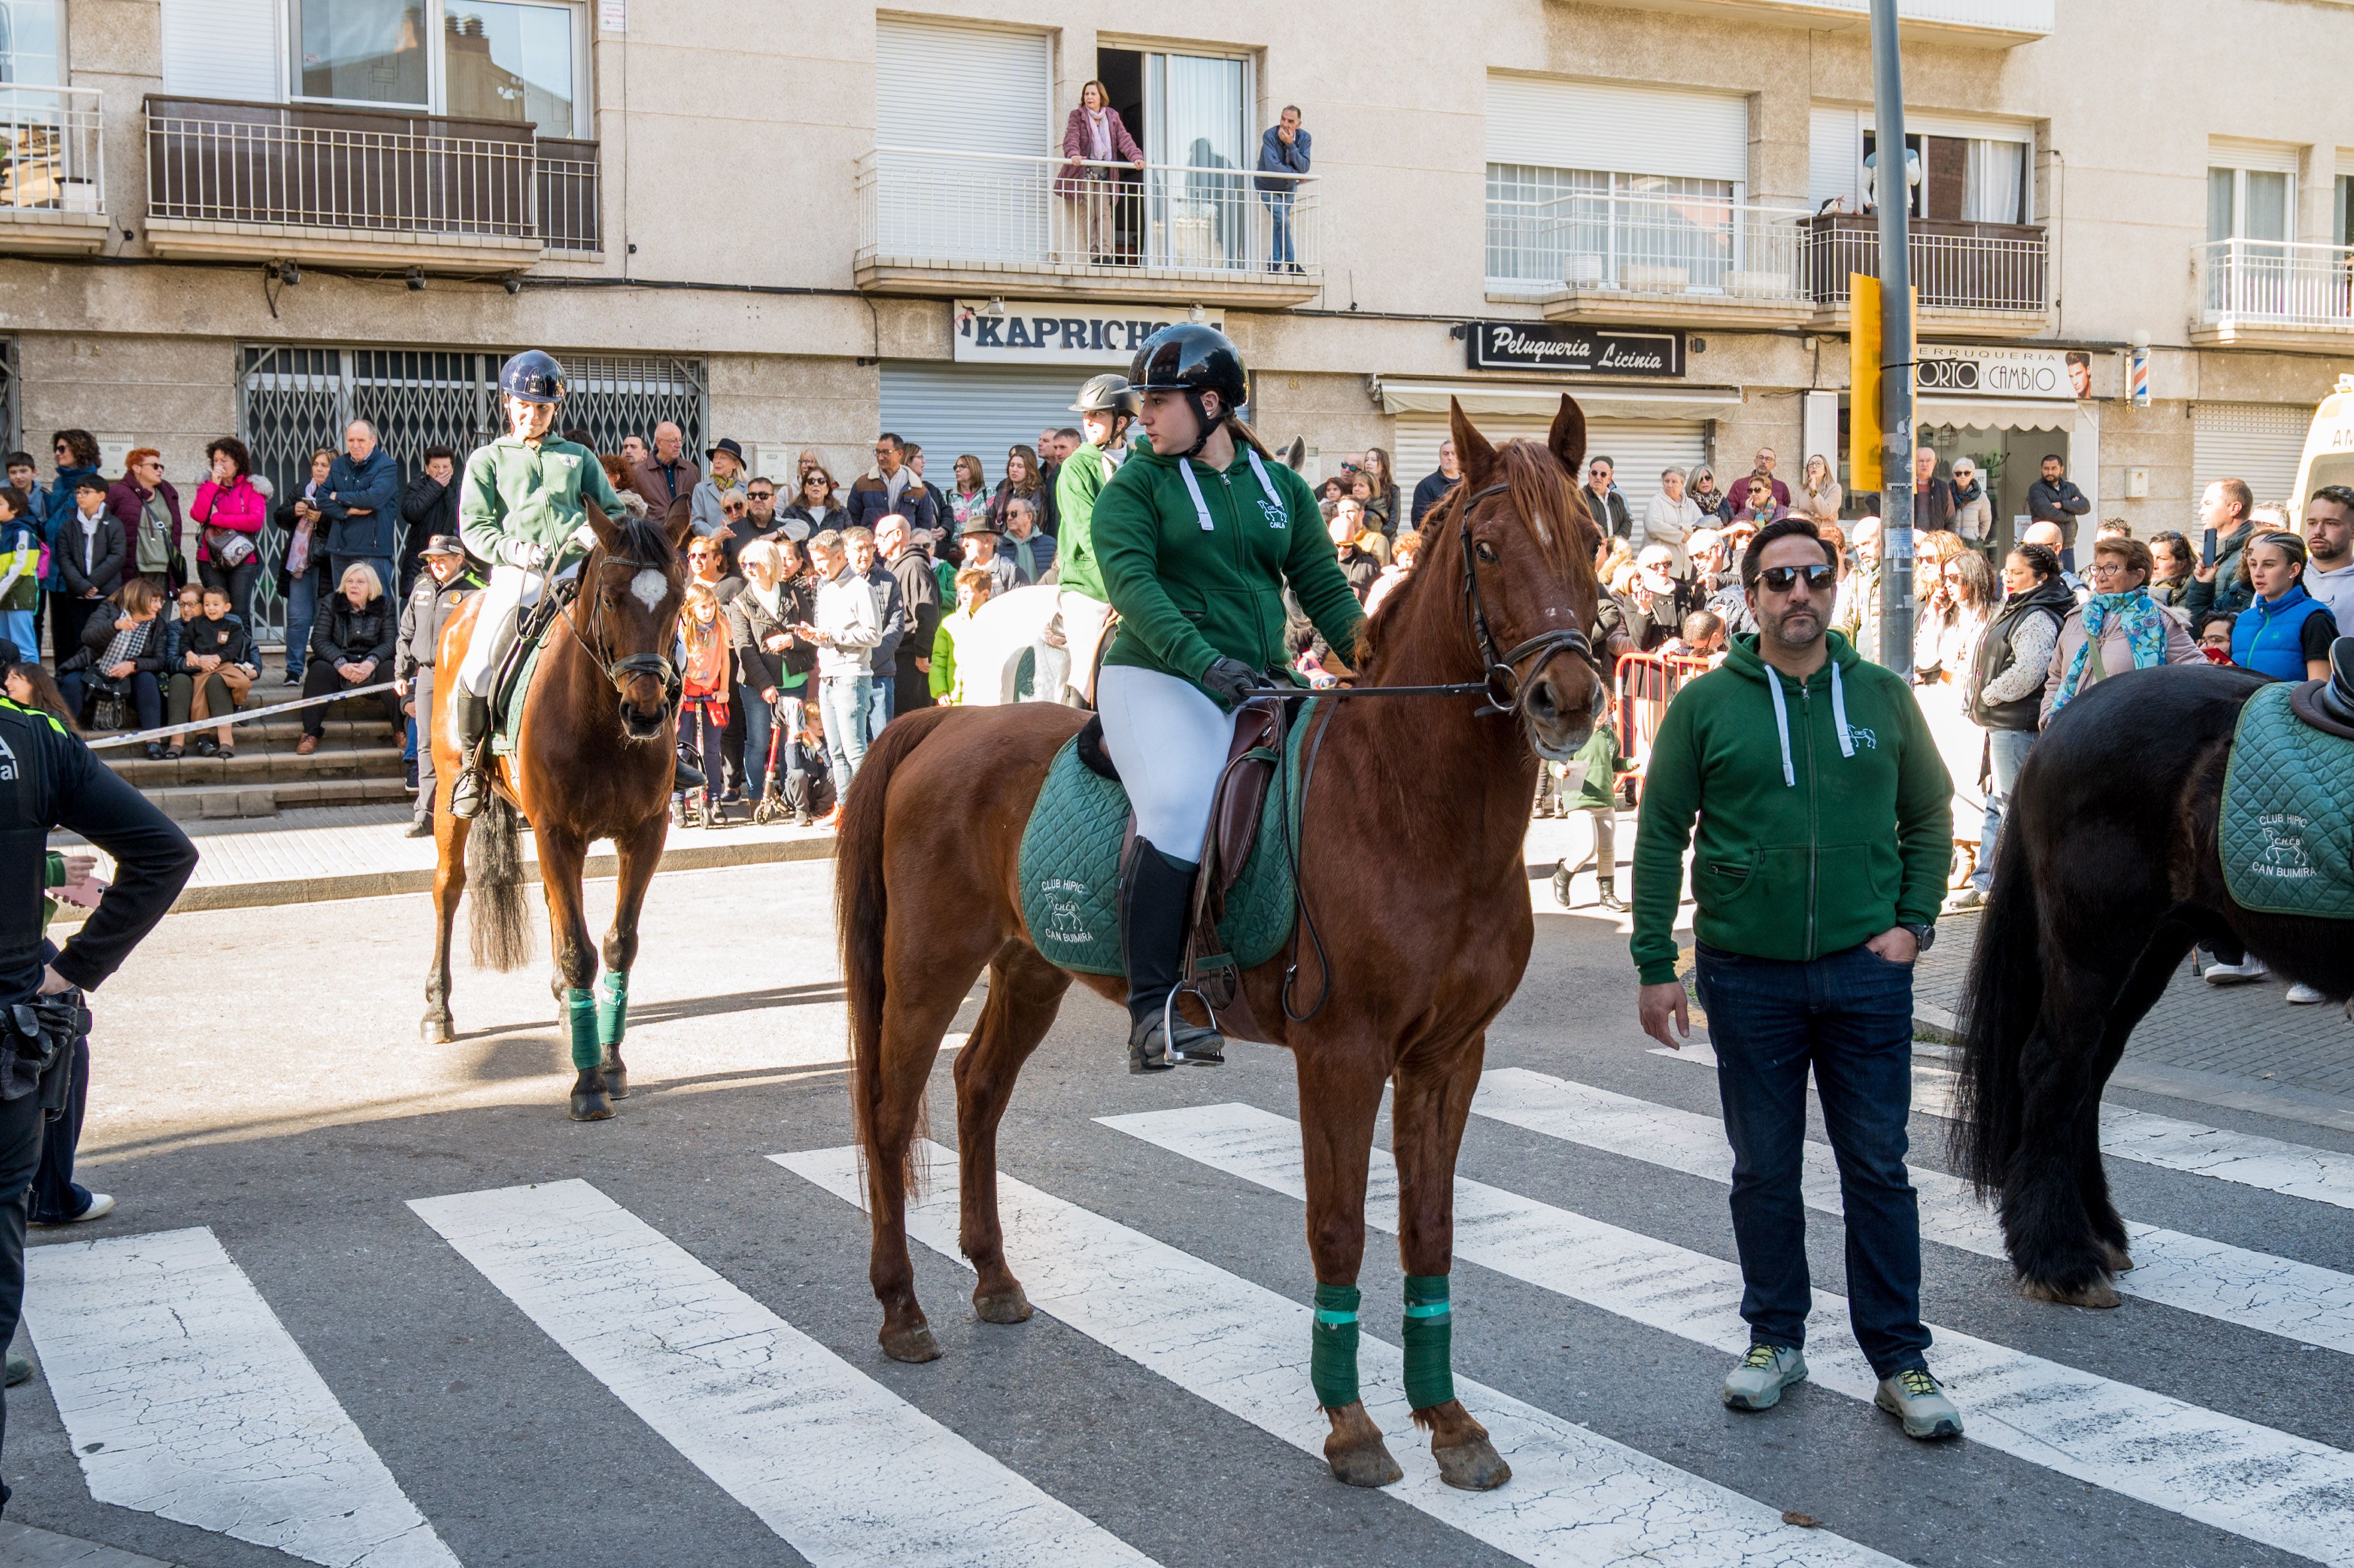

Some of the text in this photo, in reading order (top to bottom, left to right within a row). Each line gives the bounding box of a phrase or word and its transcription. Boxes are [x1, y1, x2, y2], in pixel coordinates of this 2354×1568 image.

[975, 316, 1222, 350] KAPRICH
[1492, 326, 1663, 368] Peluqueria Licinia
[1919, 347, 2056, 362] ERRUQUERIA
[1917, 360, 1979, 389] ORTO
[1989, 366, 2056, 392] CAMBIO
[2259, 814, 2308, 828] CLUB HIPIC
[2252, 861, 2317, 878] CAN BUIMIRA
[1041, 879, 1084, 893] CLUB HIPIC
[1045, 928, 1094, 943] CAN BUIMIRA
